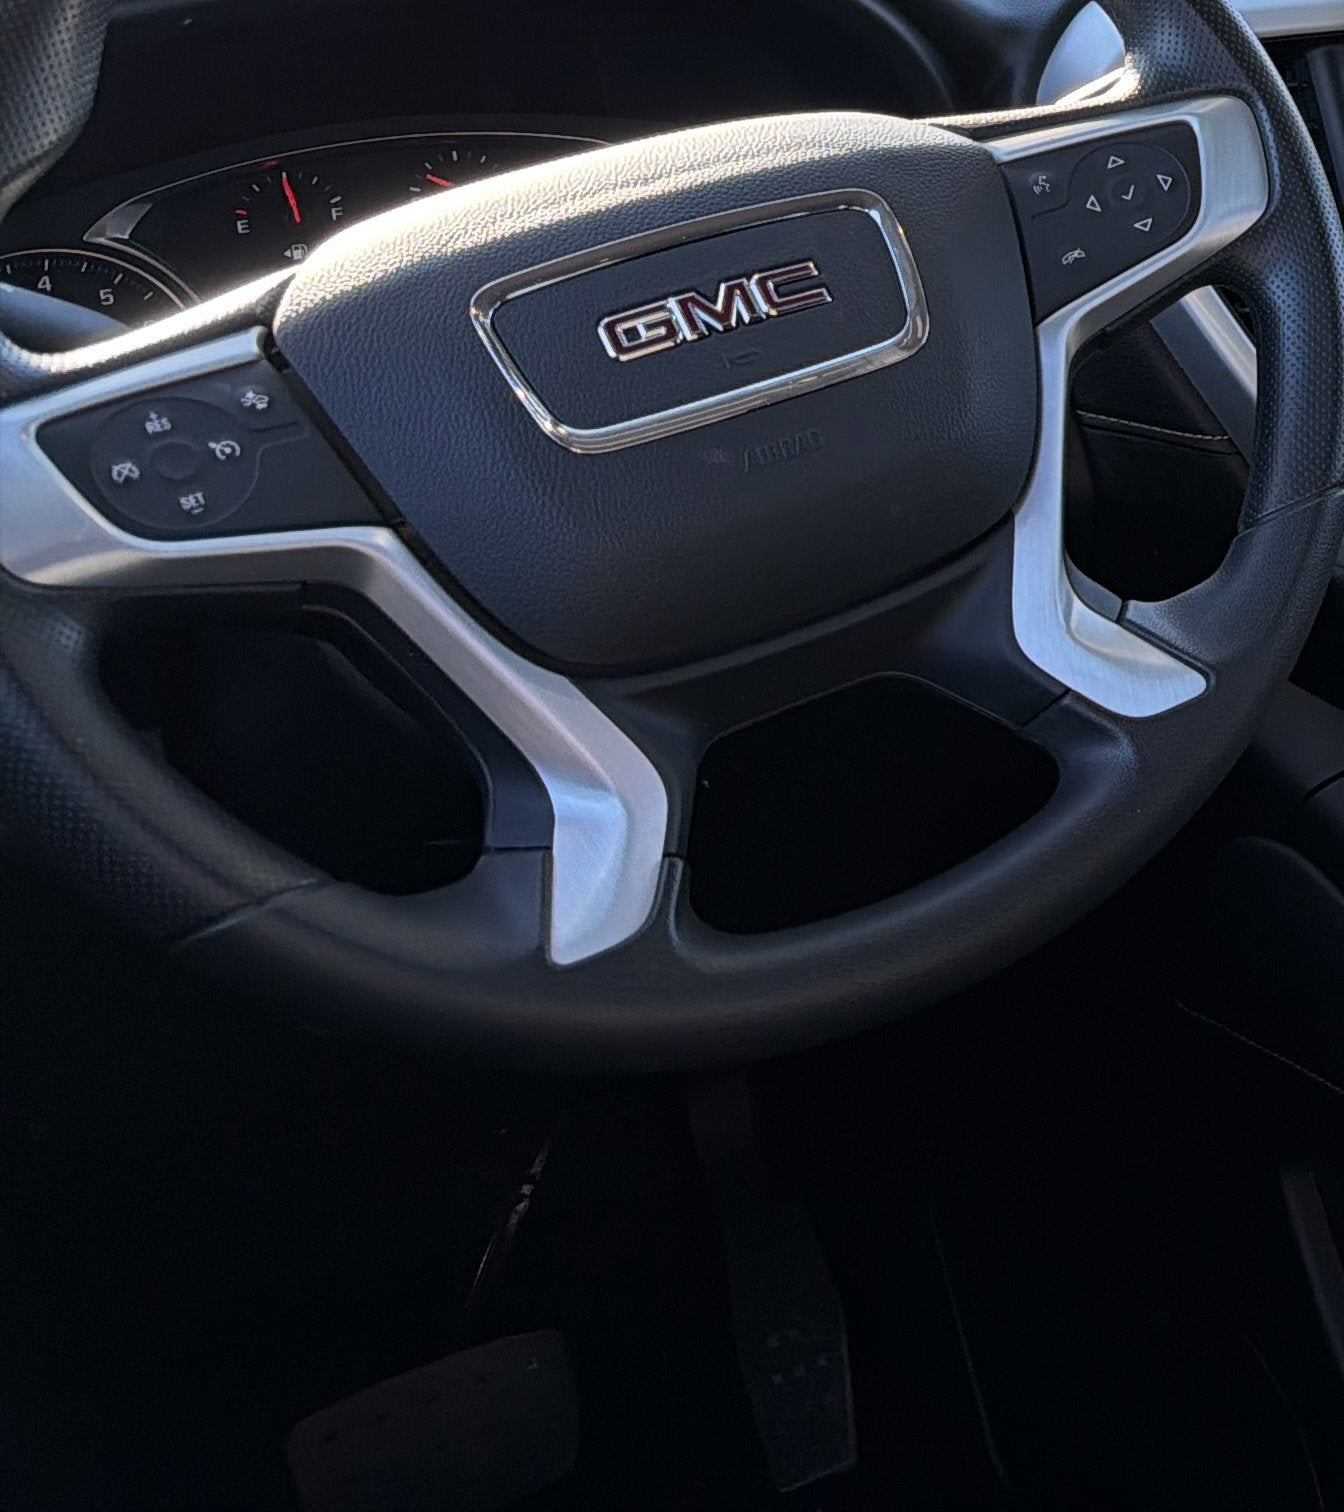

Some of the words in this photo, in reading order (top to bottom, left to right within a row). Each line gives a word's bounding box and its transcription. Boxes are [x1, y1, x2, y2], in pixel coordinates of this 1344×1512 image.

[329, 206, 344, 221] F
[235, 219, 250, 235] E
[37, 274, 52, 292] 4
[98, 287, 115, 306] 5
[597, 259, 834, 363] GMC
[144, 416, 172, 434] RES
[179, 491, 206, 511] SET
